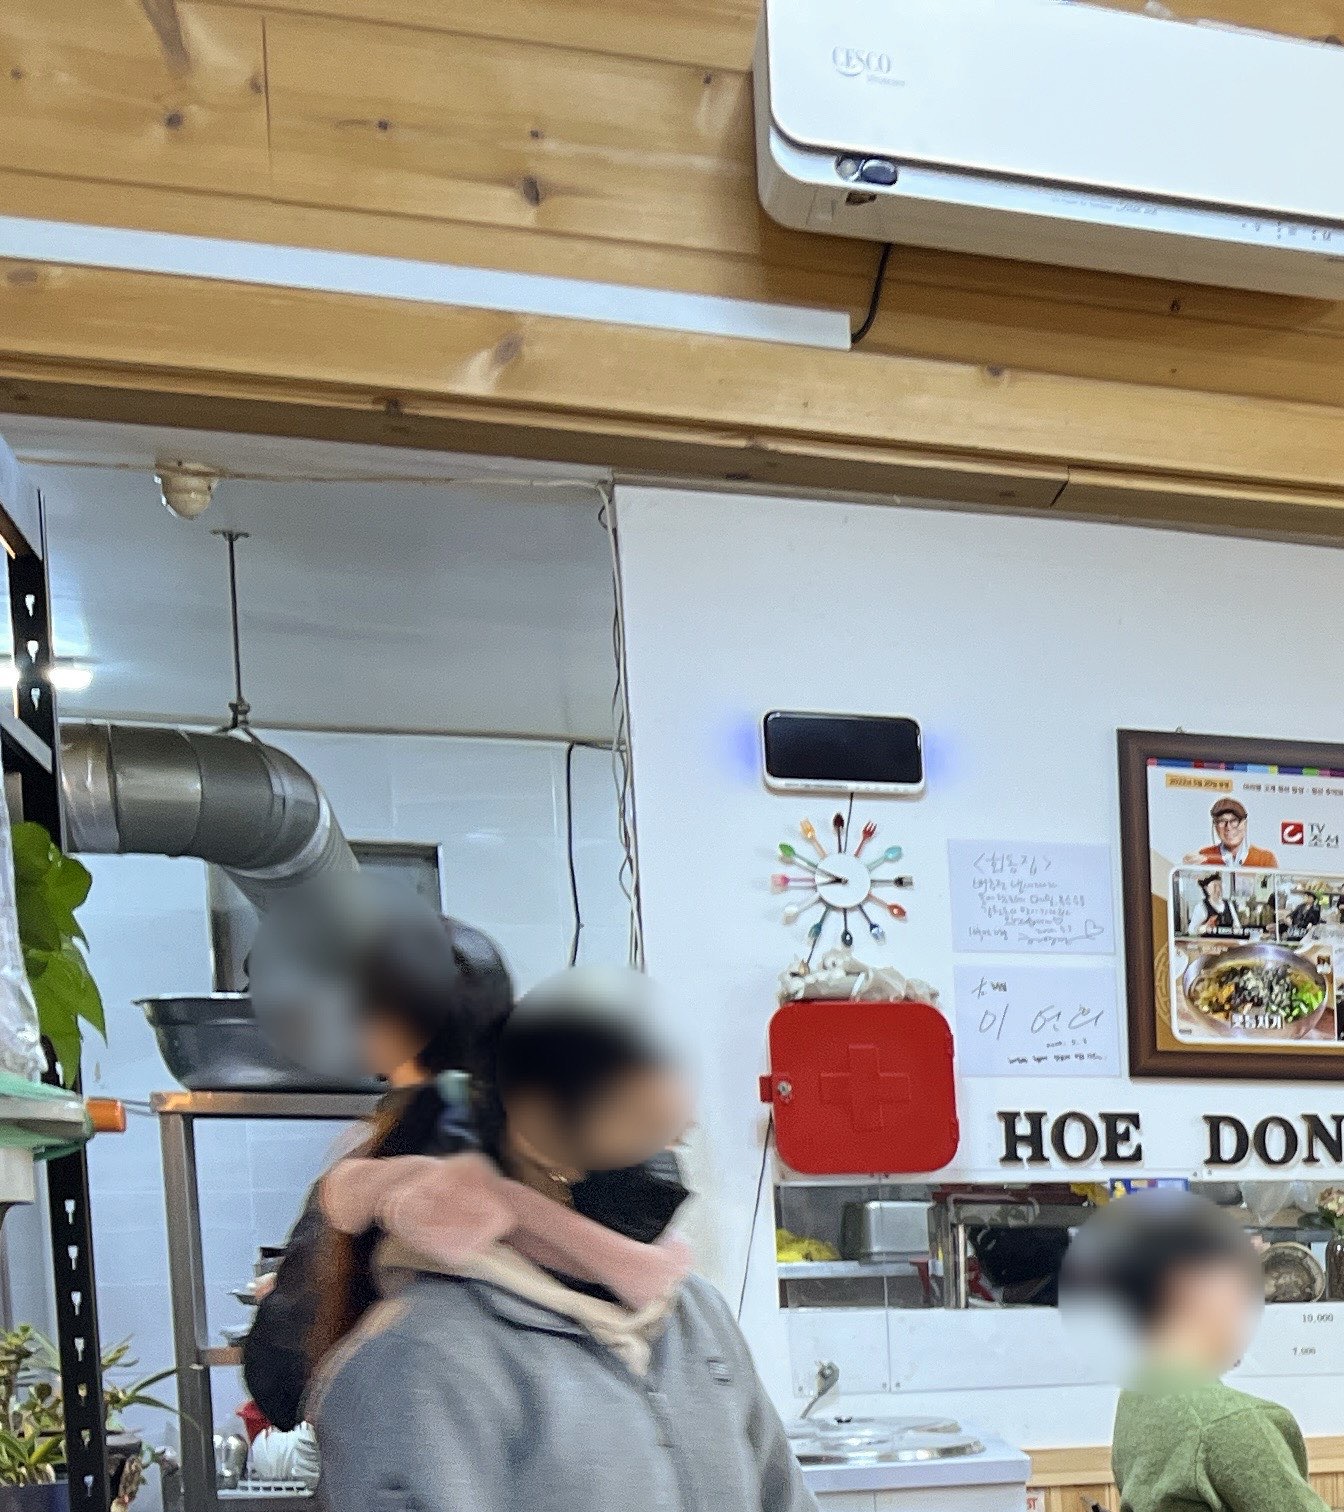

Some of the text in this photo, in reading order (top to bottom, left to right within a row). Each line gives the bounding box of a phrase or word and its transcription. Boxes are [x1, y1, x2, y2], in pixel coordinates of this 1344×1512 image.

[1309, 823, 1326, 834] TV
[1309, 834, 1339, 848] 조선
[997, 1110, 1144, 1165] HOE
